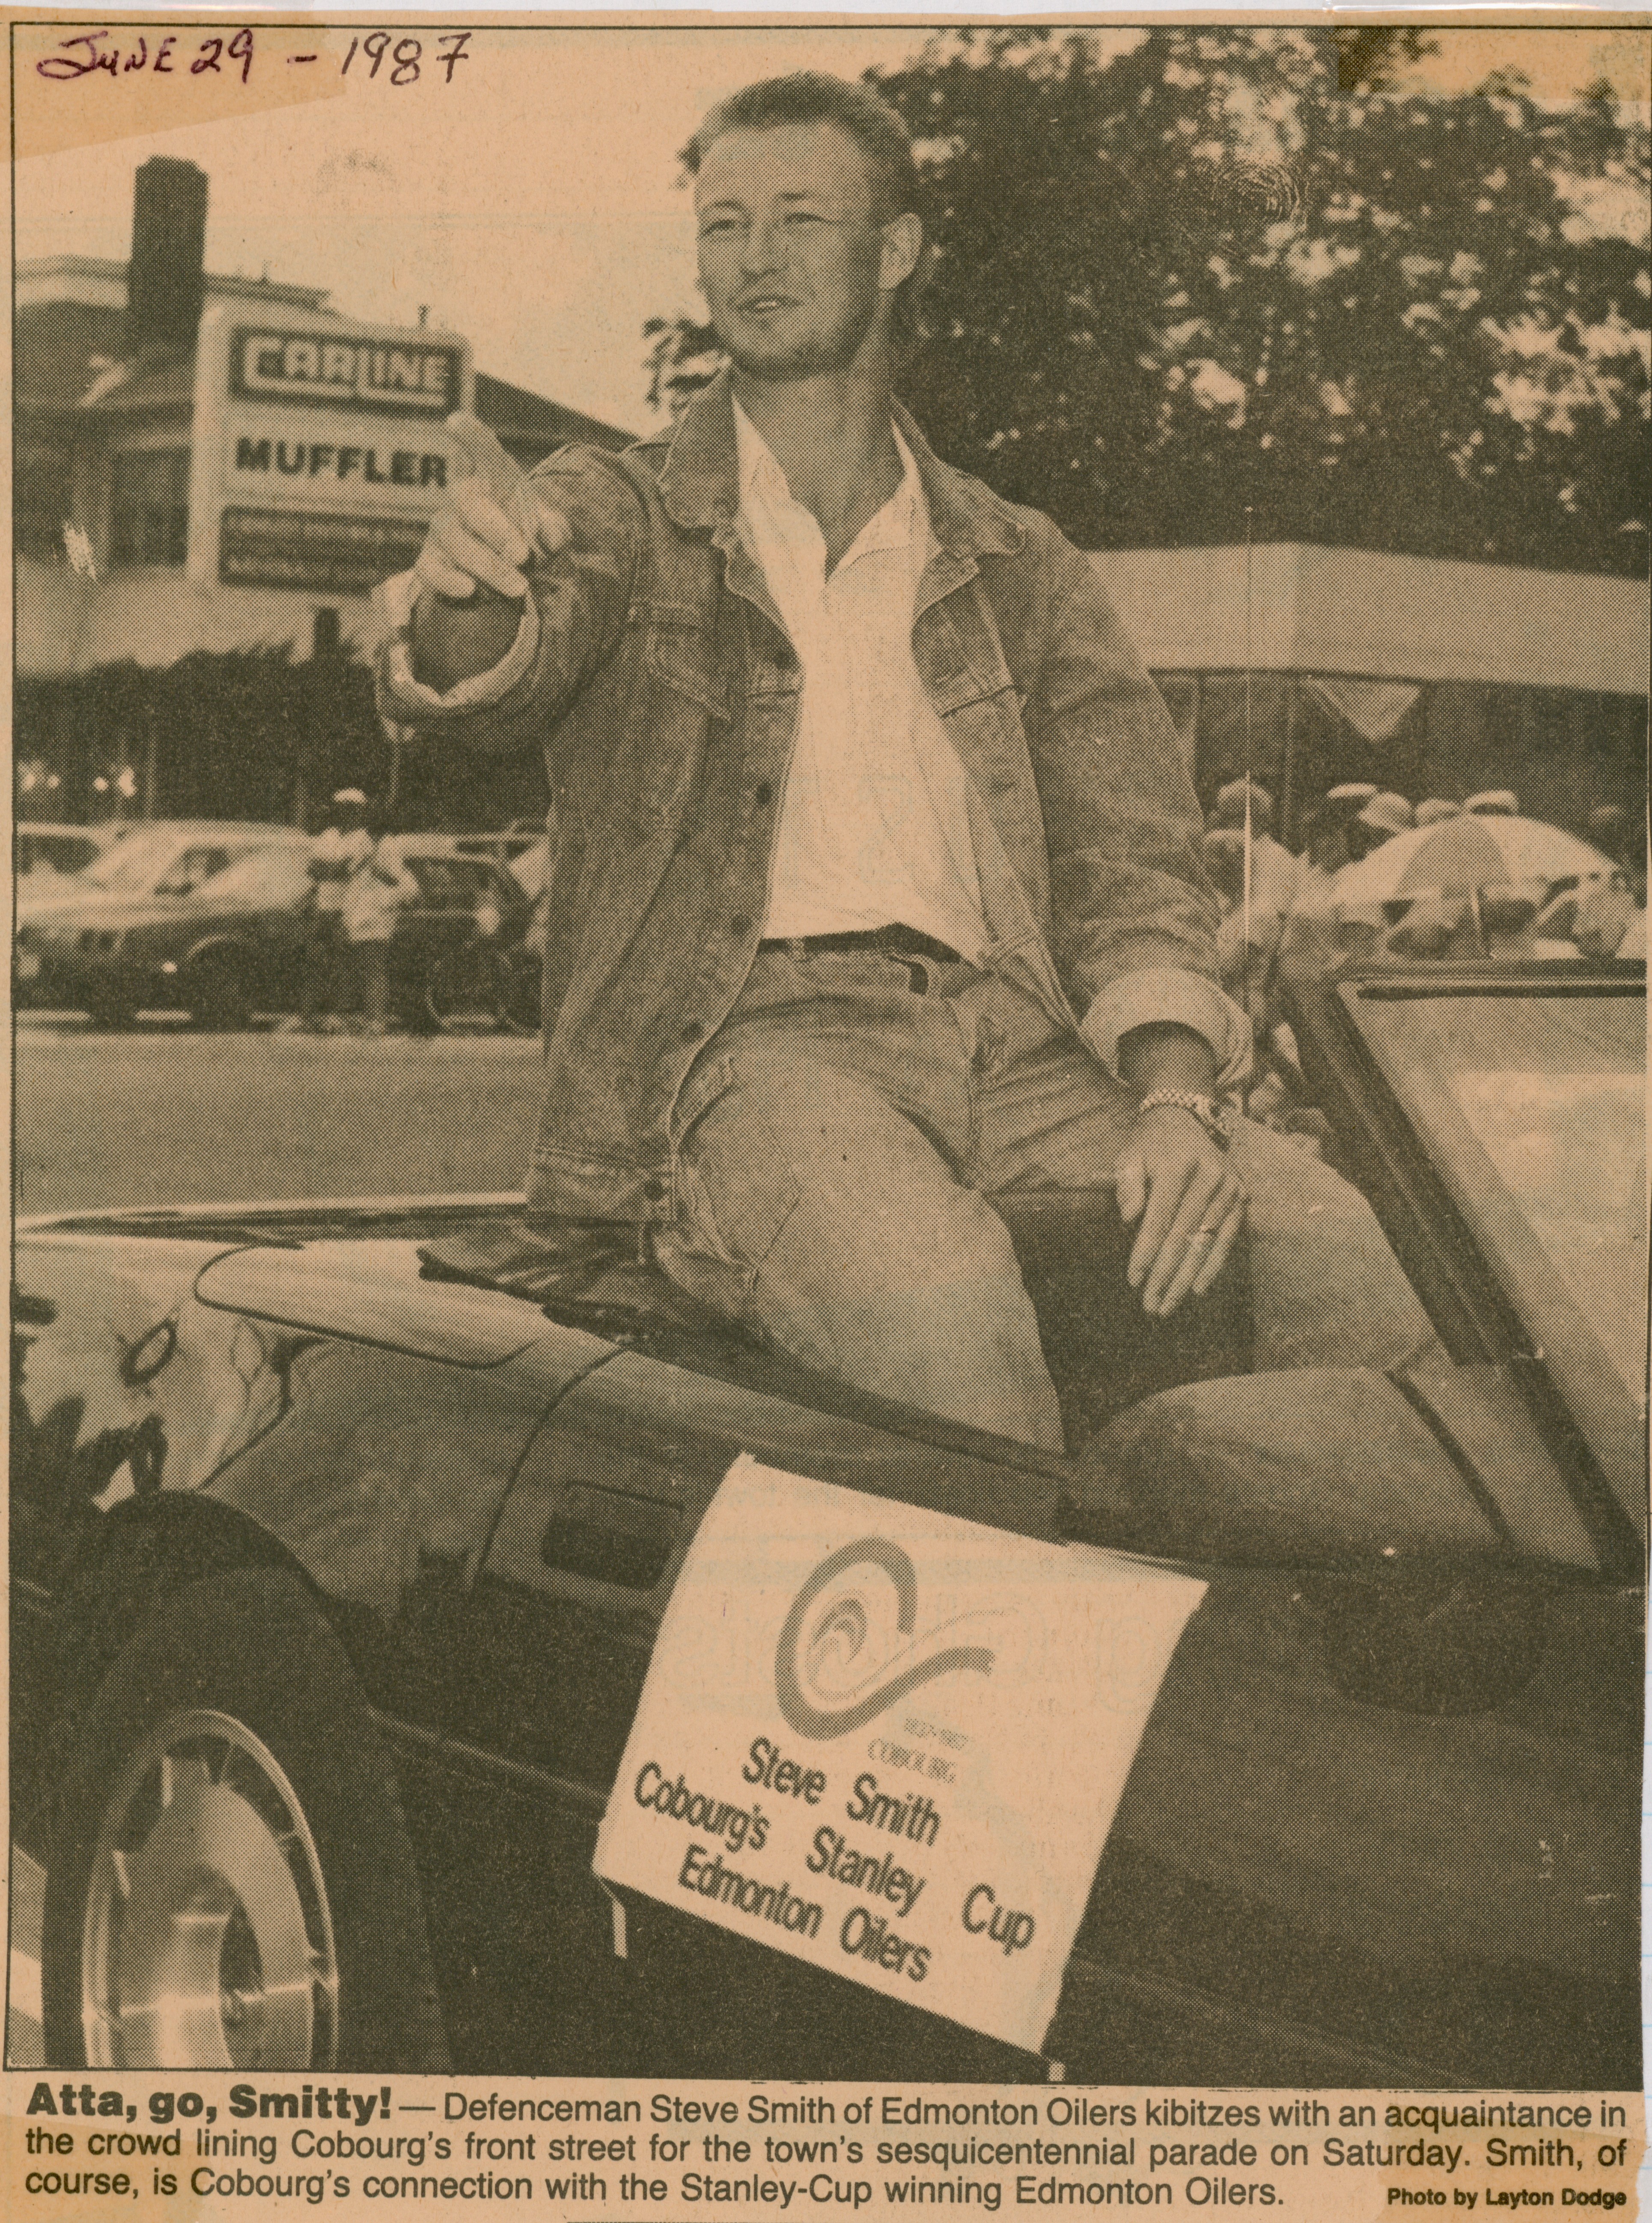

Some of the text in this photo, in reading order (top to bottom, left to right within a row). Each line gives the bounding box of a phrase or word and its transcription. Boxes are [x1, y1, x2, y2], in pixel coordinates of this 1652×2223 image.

[36, 30, 177, 80] JUNE
[190, 28, 253, 84] 29
[341, 32, 473, 86] 1987
[244, 337, 449, 407] CARLINE
[236, 437, 448, 489] MUFFLER
[868, 1738, 958, 1784] COBOURG
[742, 1737, 941, 1846] Steve Smith
[634, 1762, 1035, 1956] Cobourg's Stanley Cup
[679, 1843, 931, 1983] Edmonton Oilers
[26, 2082, 137, 2124] Atta,
[148, 2092, 218, 2125] go,
[229, 2083, 392, 2127] Smitty!
[444, 2092, 641, 2123] Defenceman
[650, 2093, 739, 2124] Steve
[747, 2094, 836, 2124] Smith
[843, 2096, 873, 2125] of
[881, 2096, 1038, 2126] Edmonton
[1046, 2096, 1137, 2127] Oilers
[1146, 2098, 1261, 2127] kibitzes
[1268, 2099, 1330, 2127] with
[1338, 2105, 1376, 2128] an
[1384, 2099, 1592, 2135] acquaintance
[1600, 2099, 1626, 2128] in
[25, 2126, 1628, 2174] the crowd lining Cobourg's front street for the town's sesquicentennial parade on Saturday. Smith, of
[24, 2166, 1284, 2212] course, is Cobourg's connection with the Stanley-Cup winning Edmonton Oilers.
[1387, 2187, 1628, 2211] Photo by Layton Dodge
